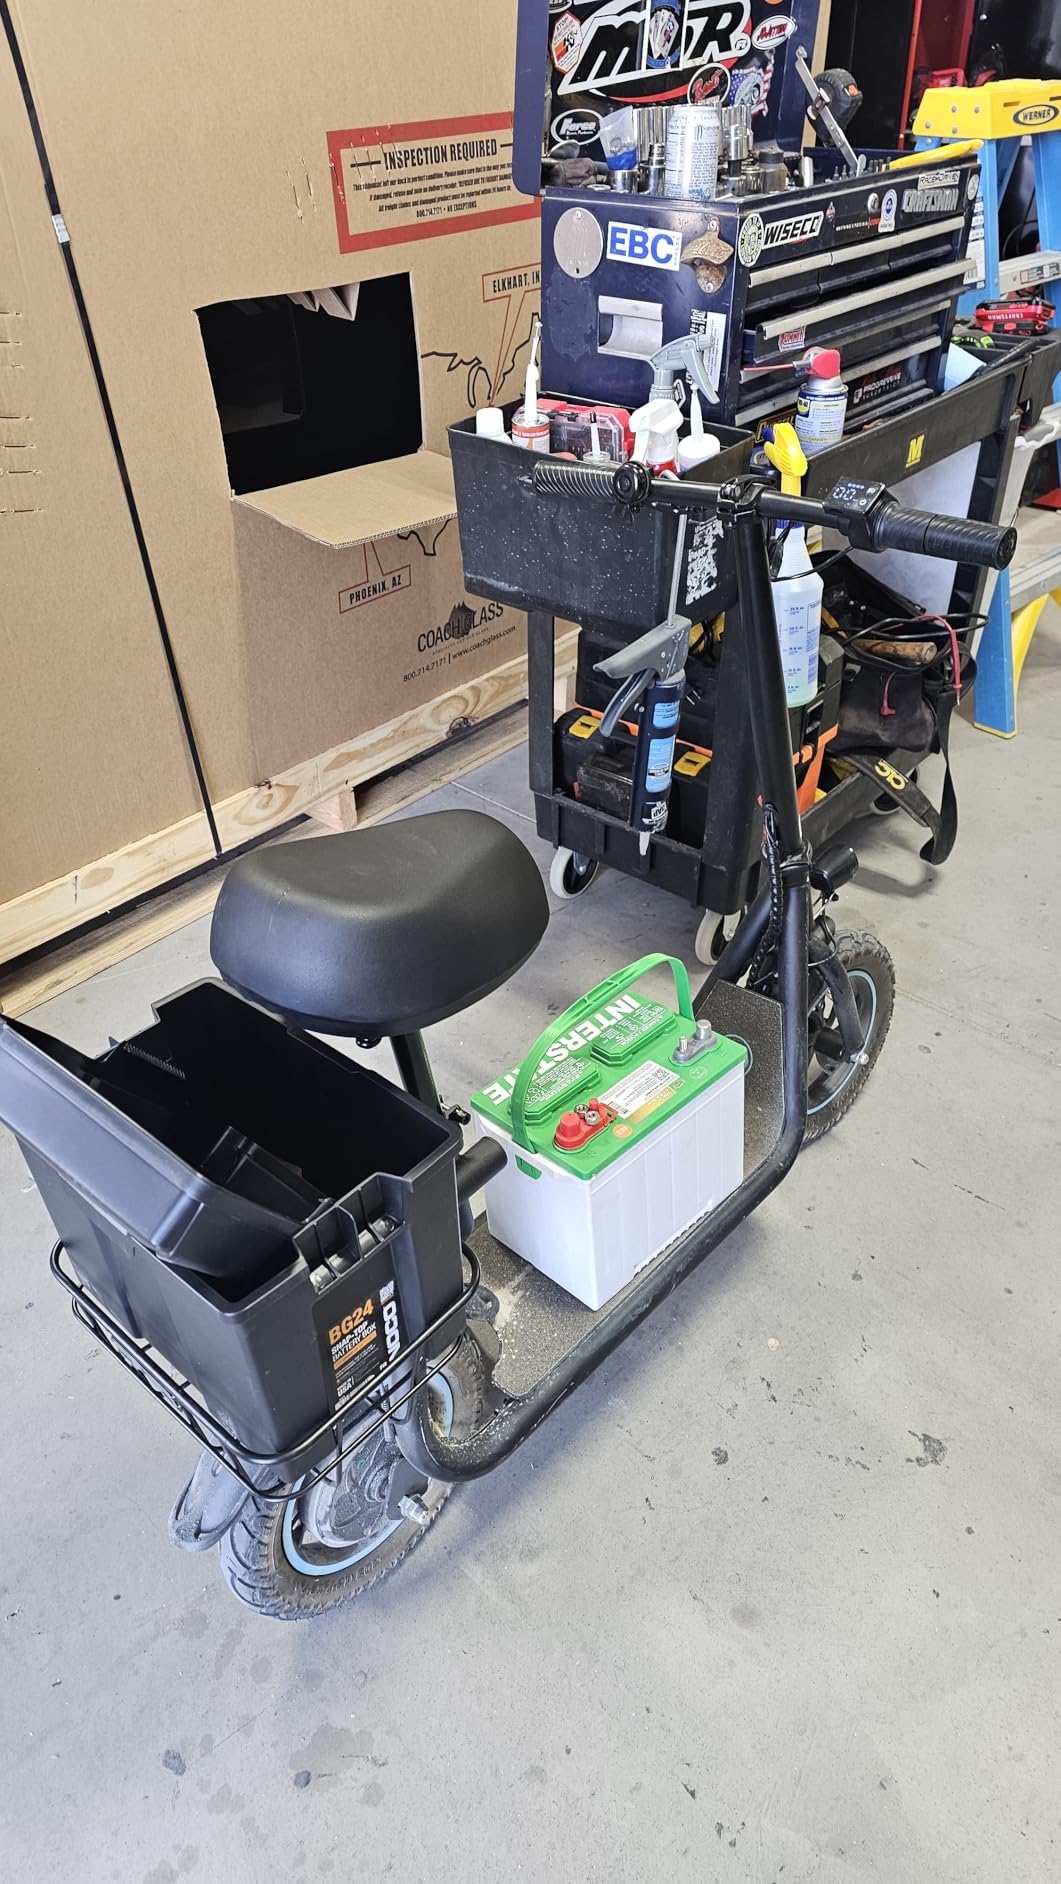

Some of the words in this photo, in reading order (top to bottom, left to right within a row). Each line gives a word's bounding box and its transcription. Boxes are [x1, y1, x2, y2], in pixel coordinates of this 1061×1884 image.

[568, 2, 747, 88] MR
[1022, 109, 1050, 120] WERNER
[384, 145, 448, 170] INSPECTION
[450, 139, 497, 161] REQUIRED
[902, 188, 959, 212] CRAFTSMAN
[609, 226, 674, 264] EBC
[492, 275, 530, 293] ELKHART,
[350, 581, 389, 604] PHOENIX,
[391, 574, 402, 587] AZ
[417, 615, 461, 653] COACH
[463, 602, 504, 632] GLASS
[403, 657, 447, 682] 800.714.7171
[452, 624, 516, 660] www.coachglass.com
[328, 1298, 374, 1345] BG24
[331, 1320, 369, 1355] SNAP-TOP
[332, 1335, 362, 1362] BATTERY
[362, 1322, 377, 1338] BOX
